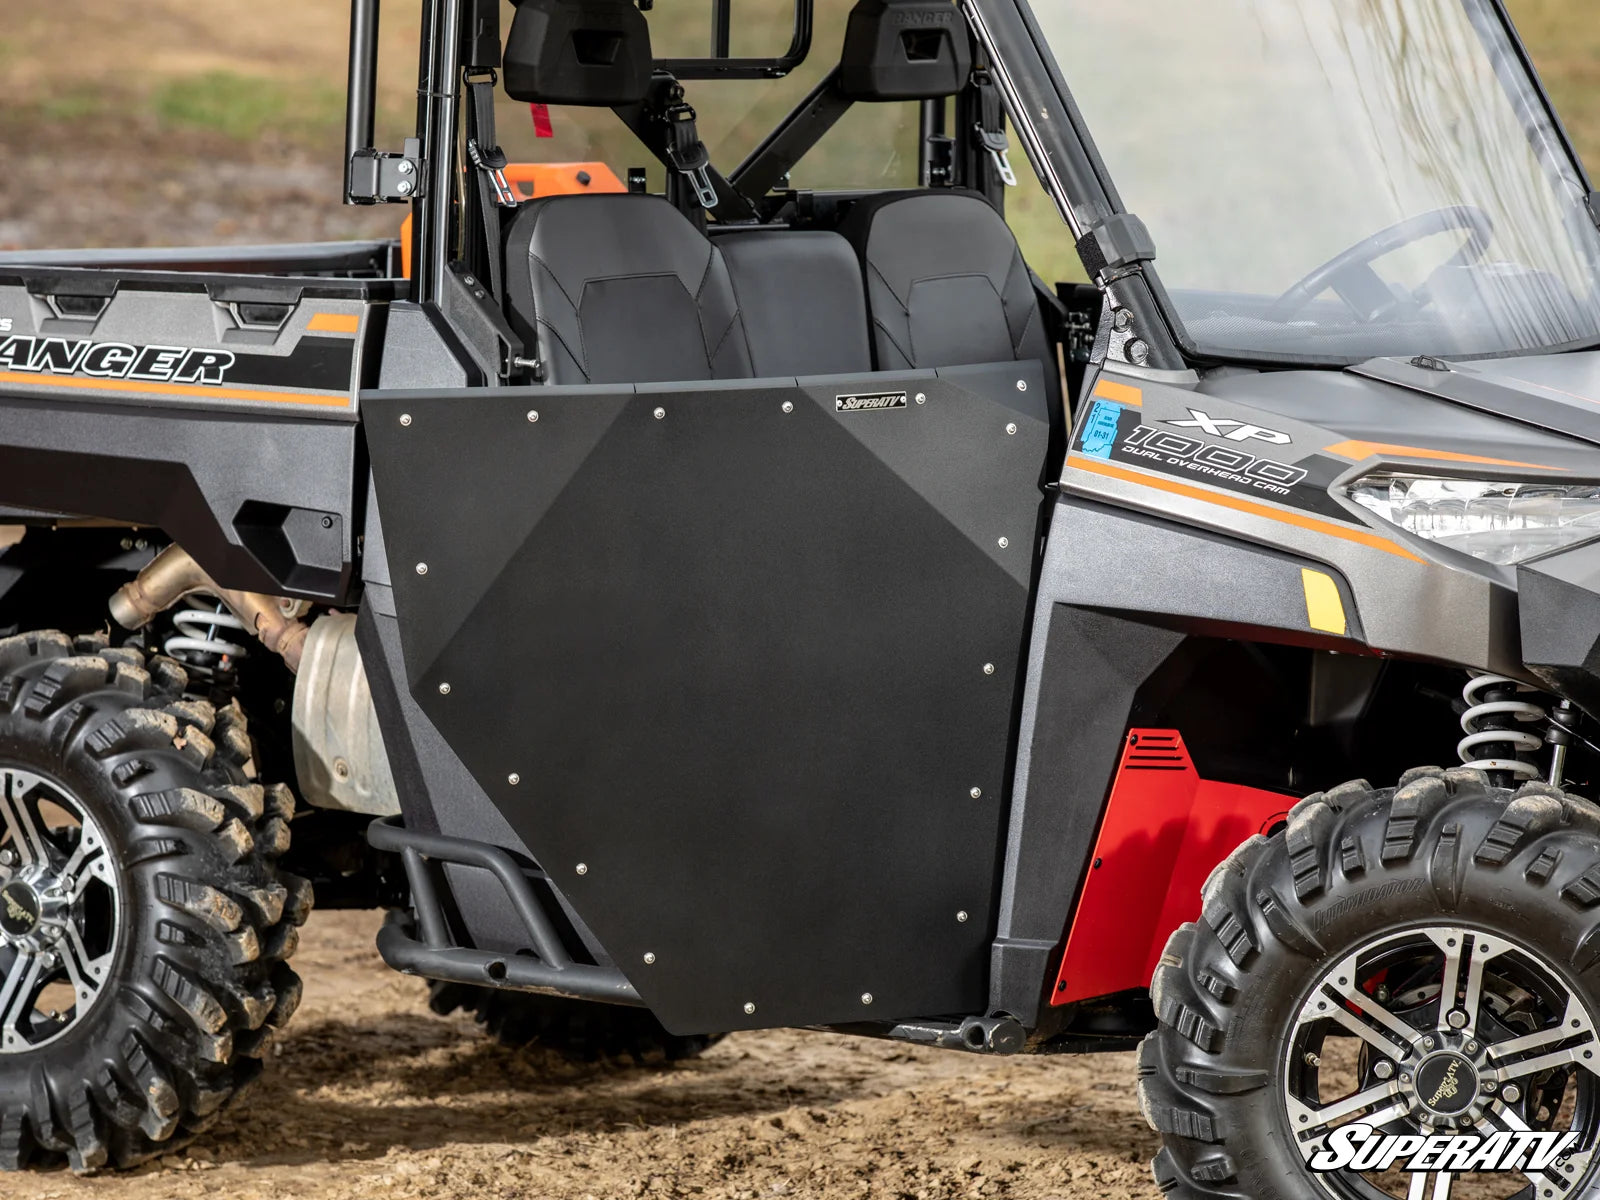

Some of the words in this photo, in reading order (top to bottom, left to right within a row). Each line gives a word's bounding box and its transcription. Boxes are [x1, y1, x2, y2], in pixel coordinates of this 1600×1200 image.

[842, 395, 900, 410] SUPERATV
[1155, 407, 1293, 446] XP
[1121, 445, 1163, 462] DUAL
[1166, 456, 1254, 485] OVERHEAD
[1252, 480, 1291, 496] CAM
[1123, 424, 1309, 487] 1000
